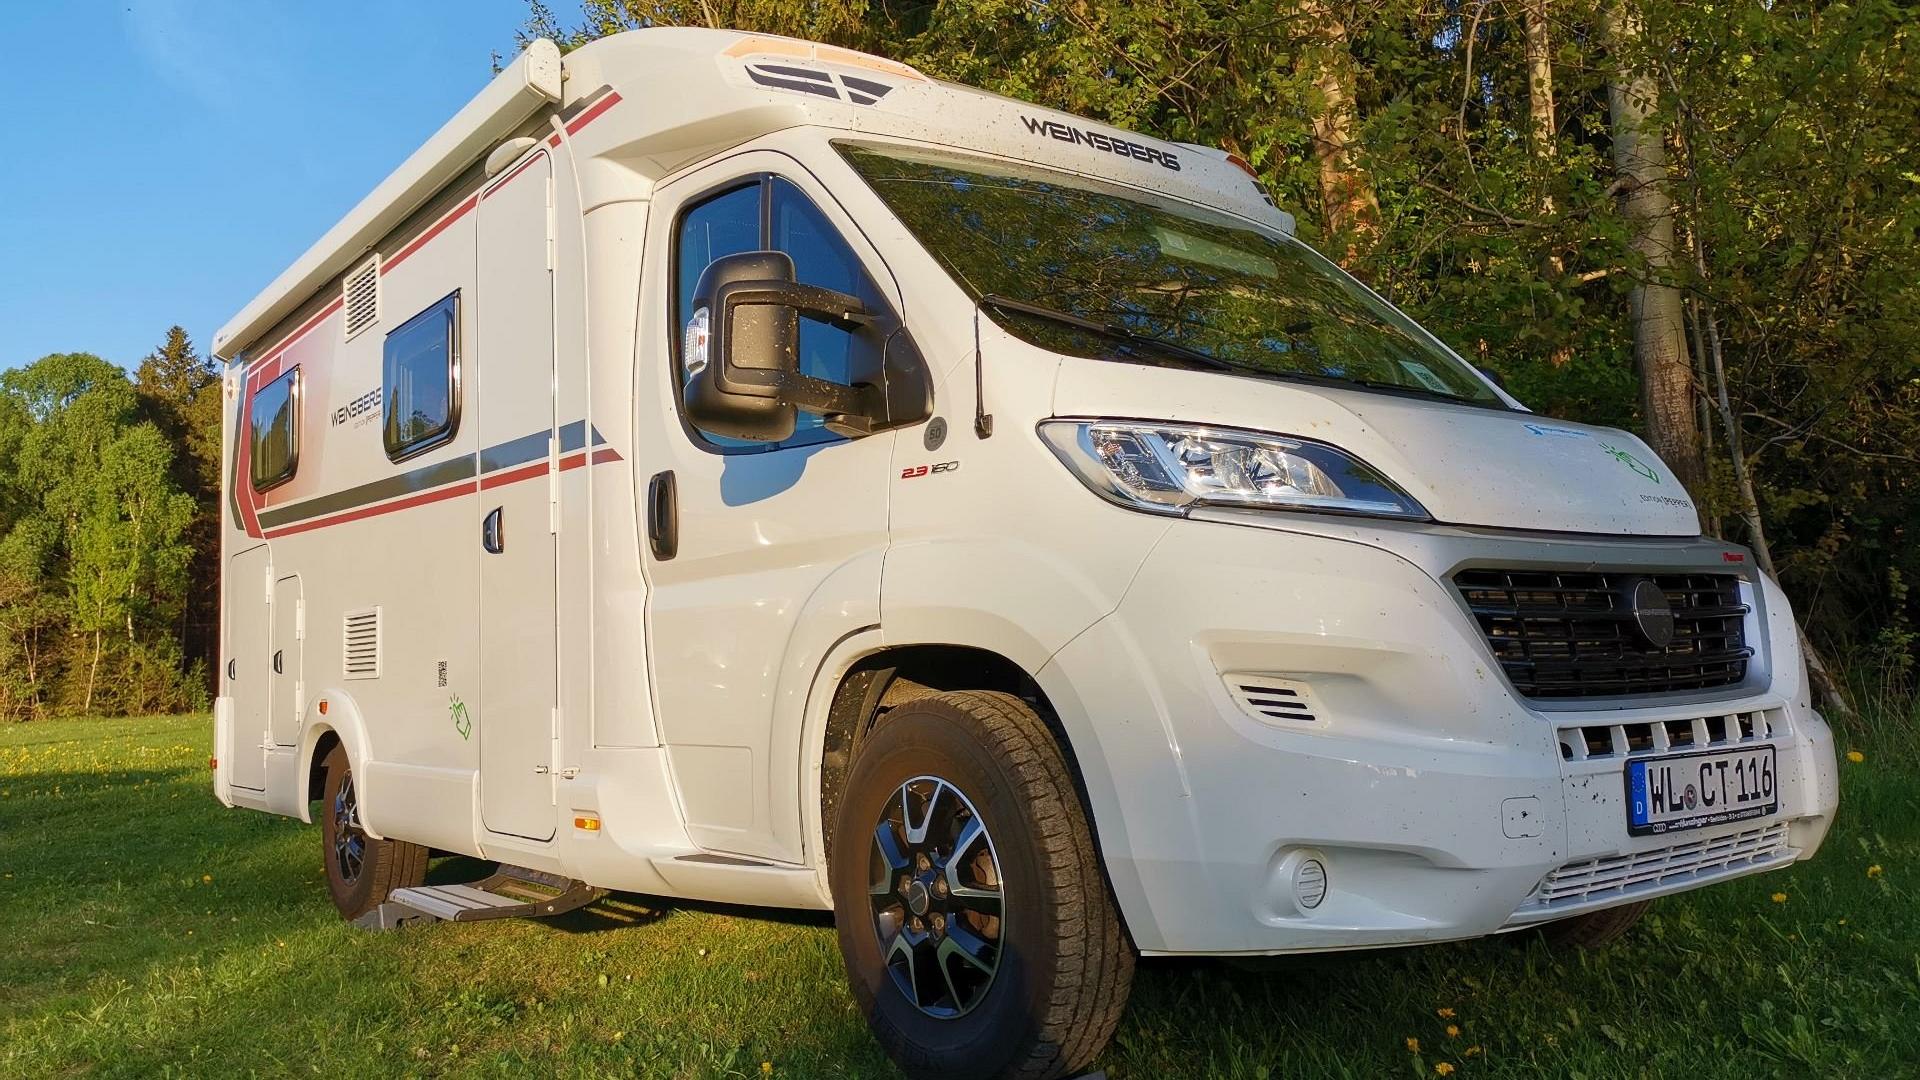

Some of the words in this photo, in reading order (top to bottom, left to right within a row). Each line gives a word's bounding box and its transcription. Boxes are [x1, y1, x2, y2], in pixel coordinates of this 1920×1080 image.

[1020, 115, 1181, 172] WEINSBERG
[331, 386, 382, 428] WEINSBERG
[1636, 801, 1643, 815] D
[1649, 766, 1685, 814] WL
[1700, 760, 1729, 807] CT
[1735, 755, 1772, 803] 116
